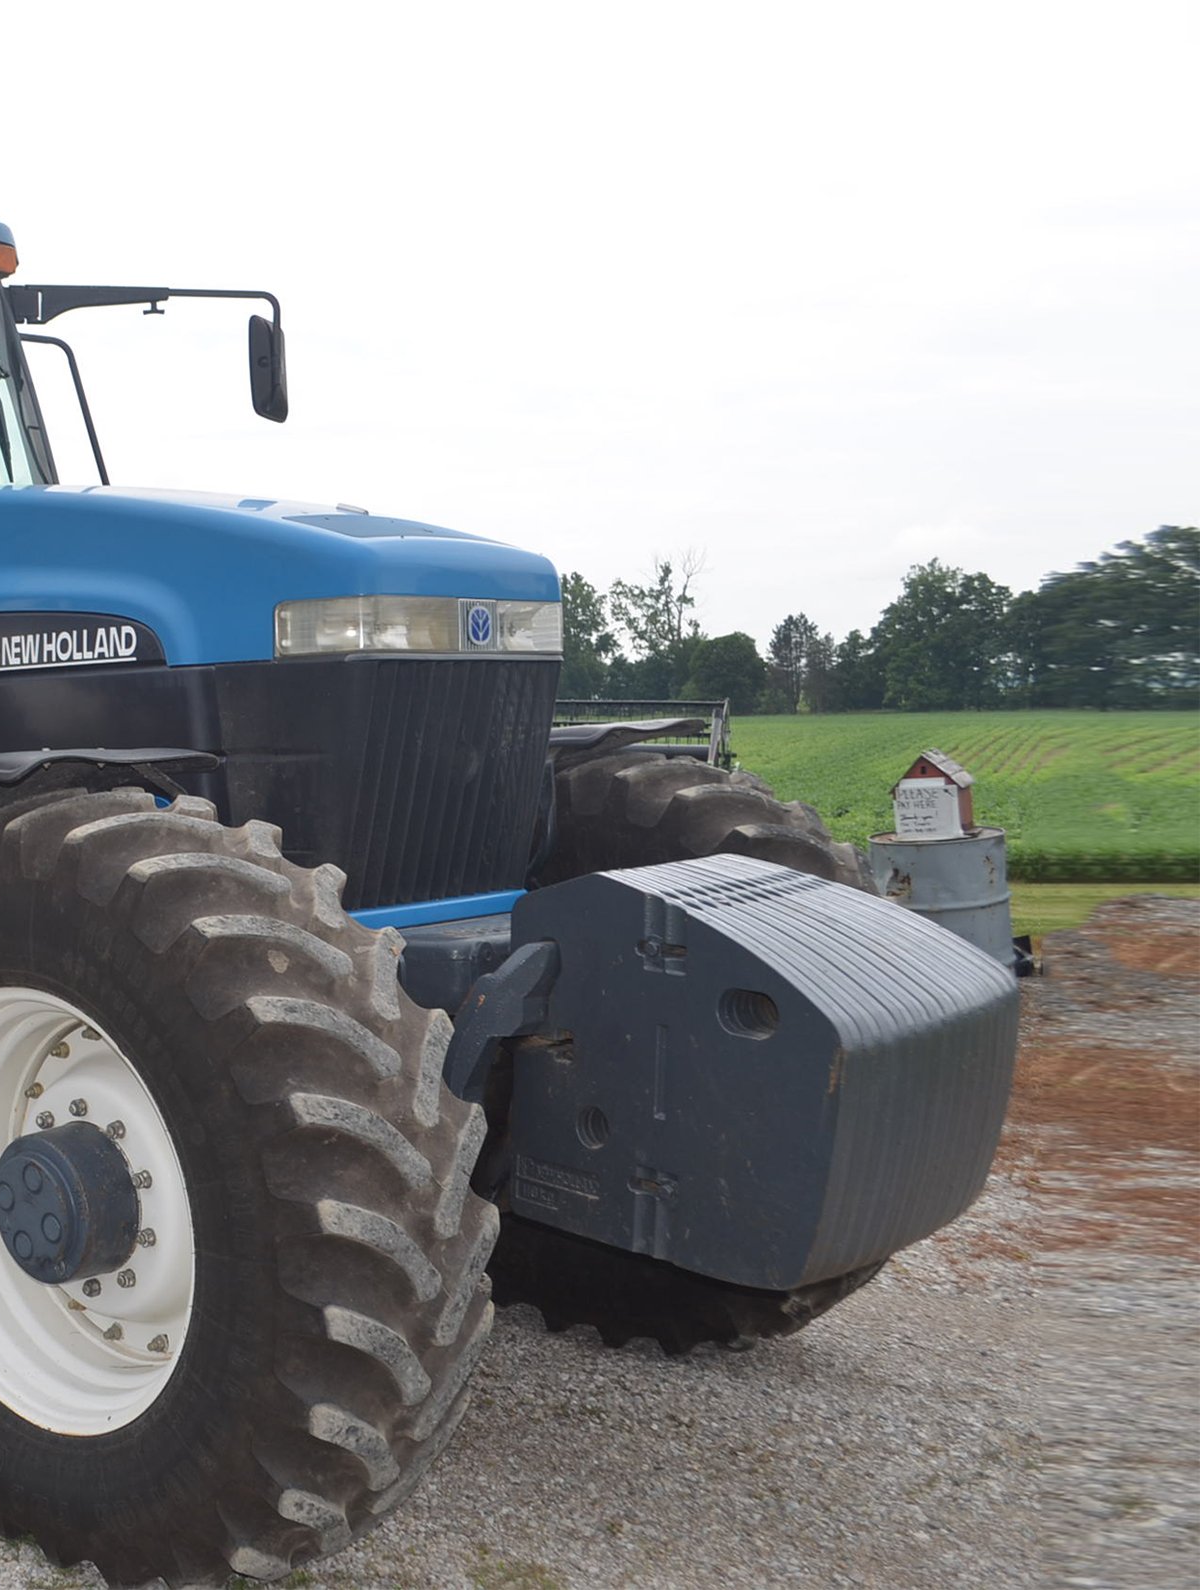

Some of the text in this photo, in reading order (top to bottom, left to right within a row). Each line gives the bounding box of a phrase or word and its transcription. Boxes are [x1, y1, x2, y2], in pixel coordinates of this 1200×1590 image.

[1, 634, 40, 666] NEW
[43, 625, 137, 664] HOLLAND
[897, 788, 938, 800] PLEASE
[897, 800, 937, 810] PAY HERE
